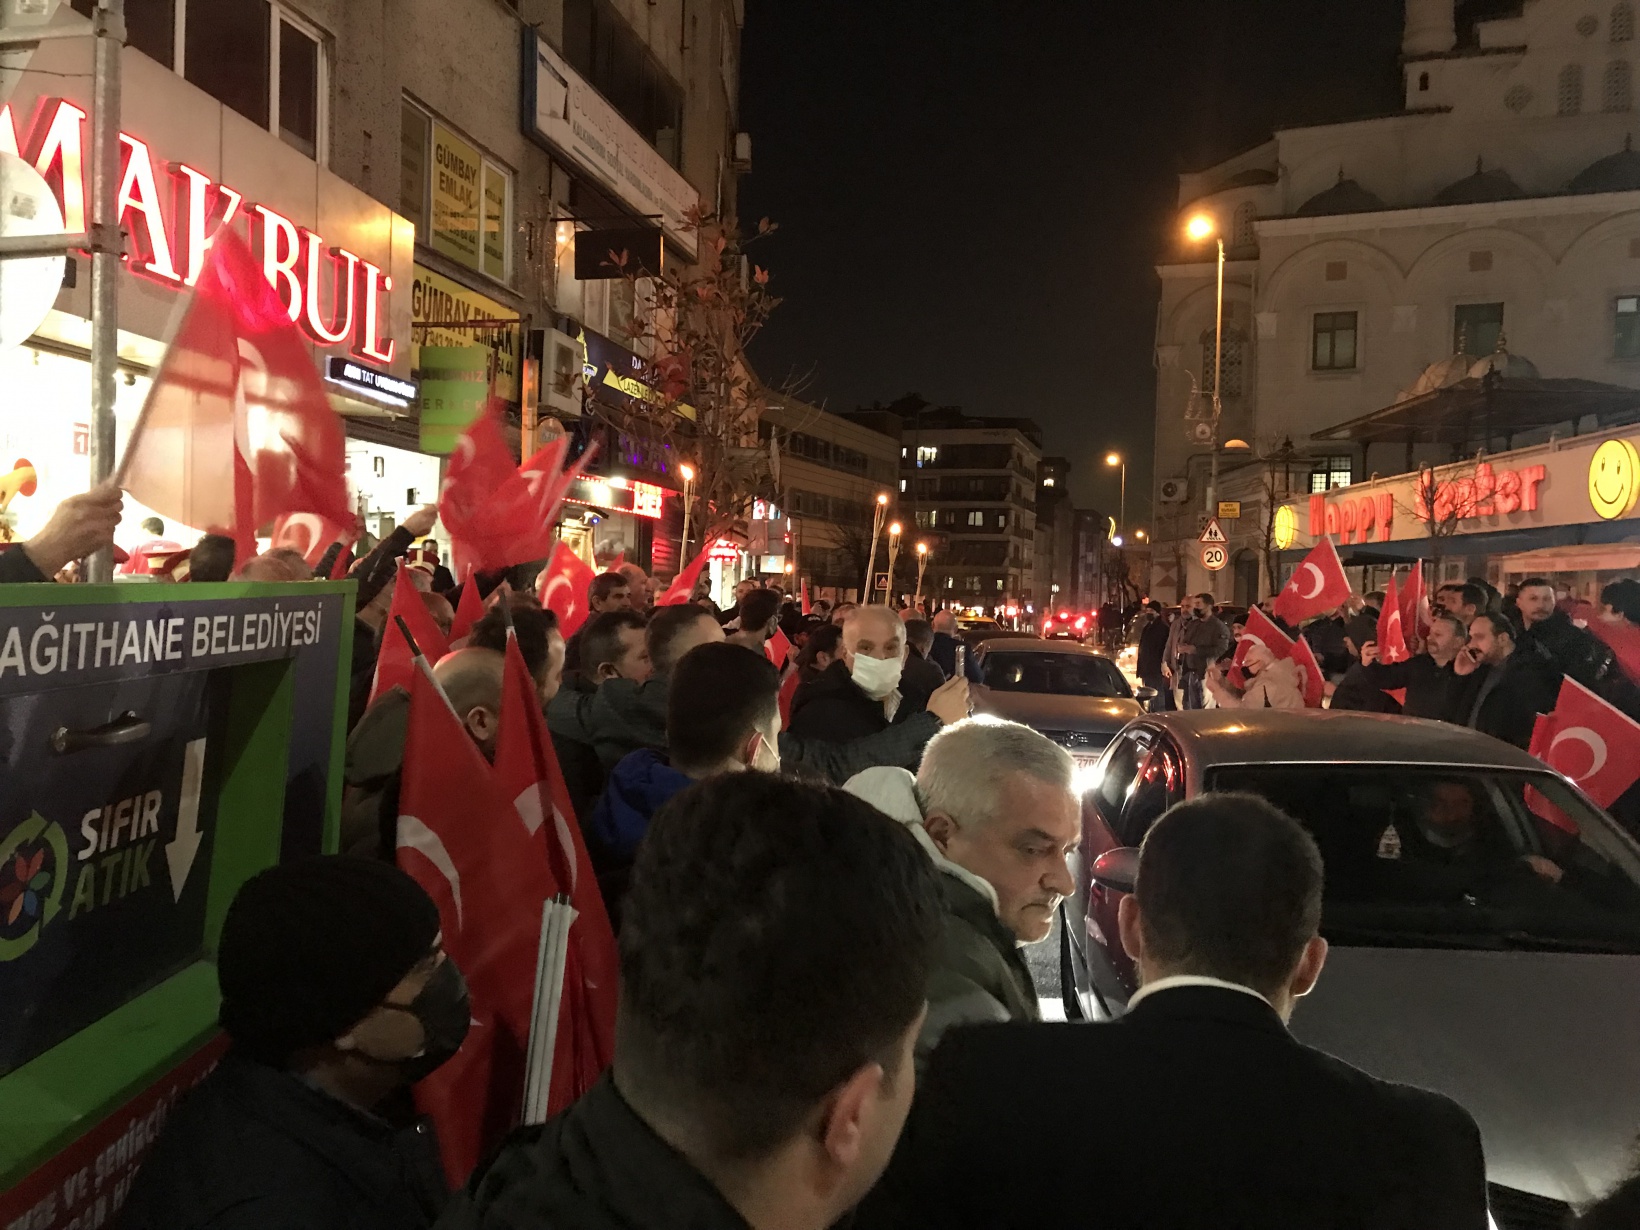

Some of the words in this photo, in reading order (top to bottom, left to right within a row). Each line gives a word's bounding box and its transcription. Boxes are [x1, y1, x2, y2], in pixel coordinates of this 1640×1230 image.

[435, 142, 477, 187] GÜMBAY
[438, 170, 473, 209] EMLAK
[411, 276, 470, 336] GÜMBAY
[473, 306, 514, 356] EMLAK
[361, 369, 375, 385] TAT
[1205, 550, 1223, 563] 20
[191, 602, 322, 658] BELEDİYESİ
[77, 790, 162, 861] SIFIR
[68, 839, 157, 921] ATIK
